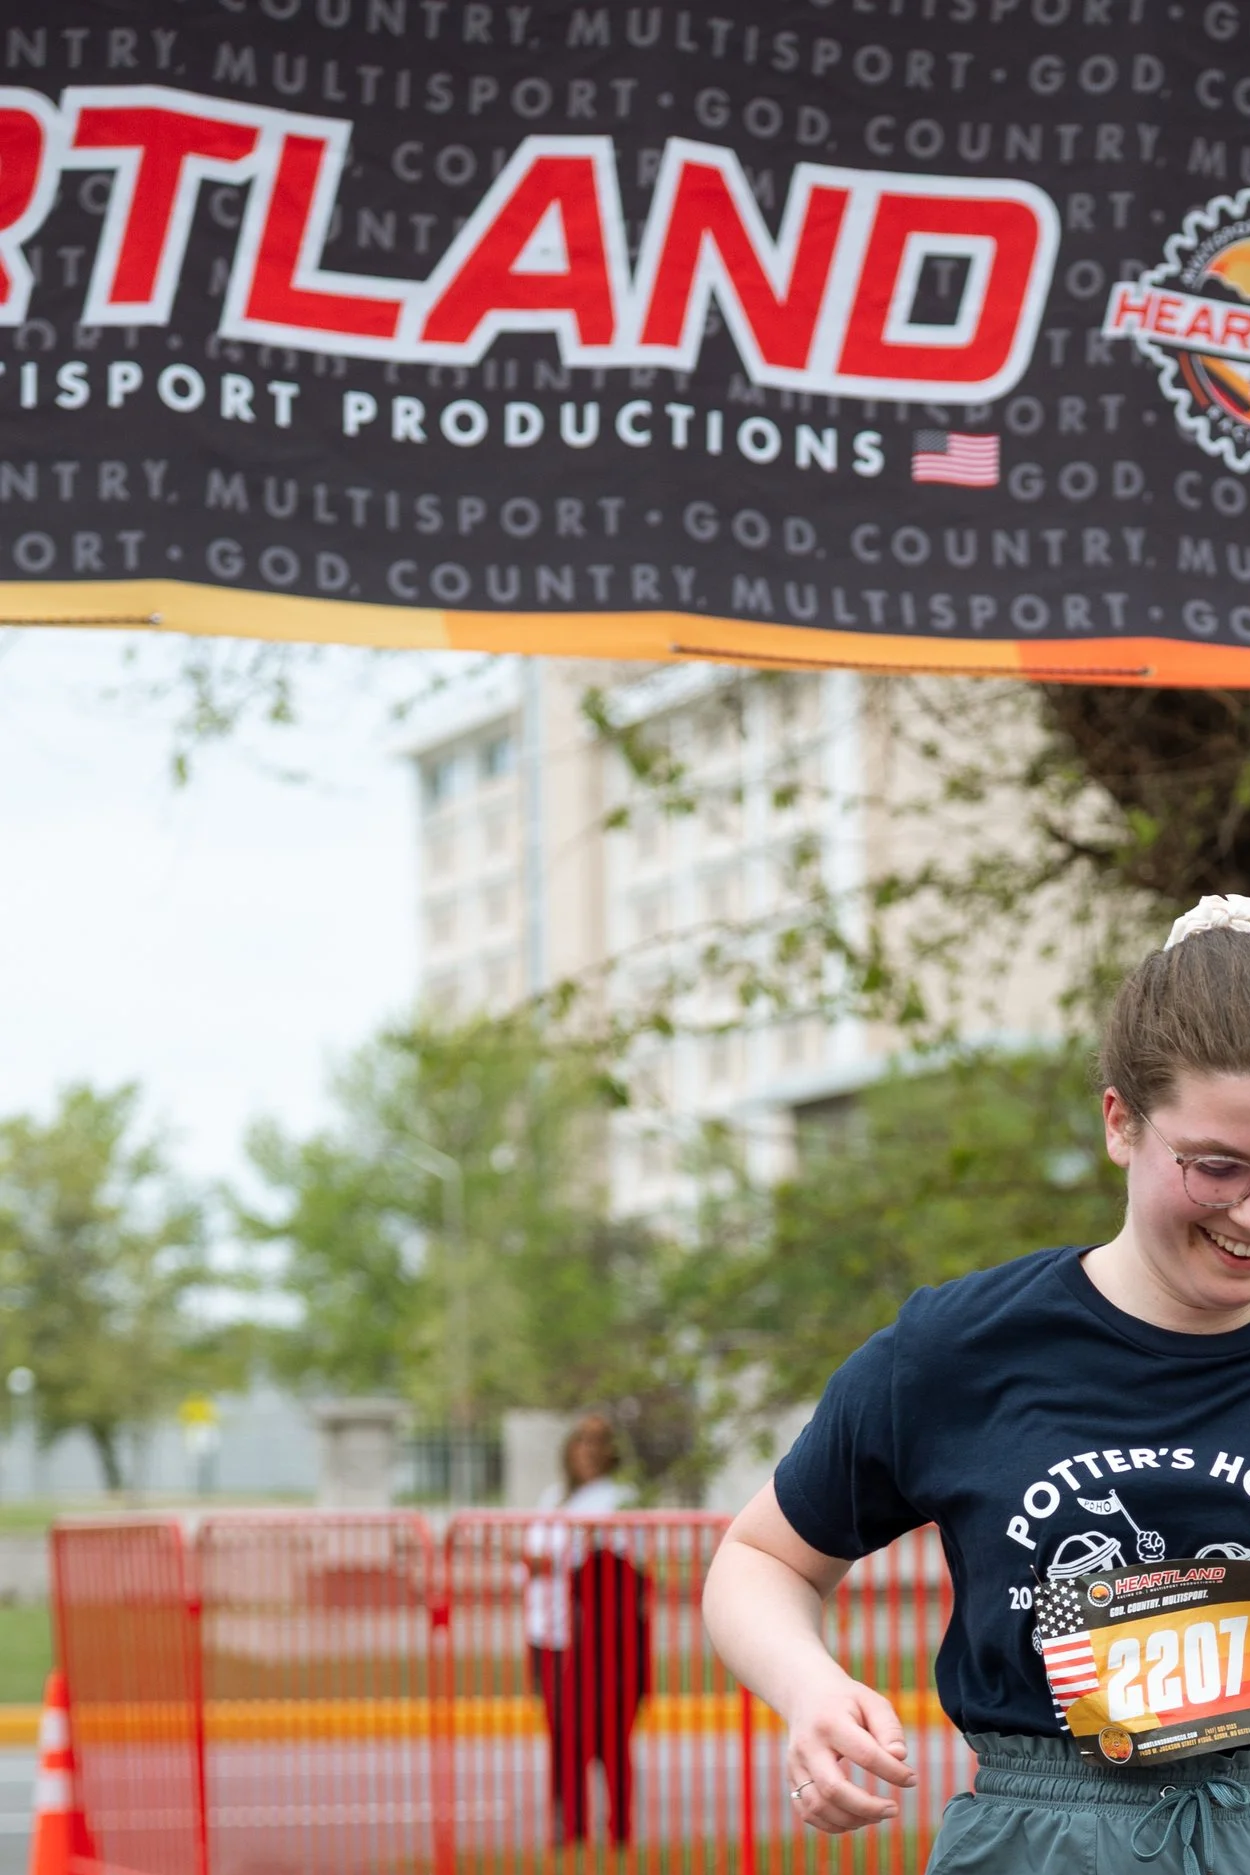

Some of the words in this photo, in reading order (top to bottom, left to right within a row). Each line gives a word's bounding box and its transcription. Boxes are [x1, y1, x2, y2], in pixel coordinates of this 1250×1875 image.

[211, 41, 638, 119] MULTISPORT
[567, 6, 974, 92] MULTISPORT
[0, 360, 301, 428] ISPORT
[342, 390, 885, 478] PRODUCTIONS
[205, 467, 625, 540] MULTISPORT
[12, 529, 146, 574] ORT
[731, 572, 1130, 634] MULTISPORT
[1006, 1447, 1195, 1550] POTTER'S
[1084, 1500, 1112, 1512] POHO
[1008, 1586, 1033, 1609] 20
[1109, 1605, 1126, 1618] GOD.
[1127, 1598, 1161, 1614] COUNTRY.
[1161, 1589, 1209, 1606] MULTISPORT.
[1115, 1567, 1226, 1595] HEARTLAND
[1107, 1616, 1249, 1722] 2207
